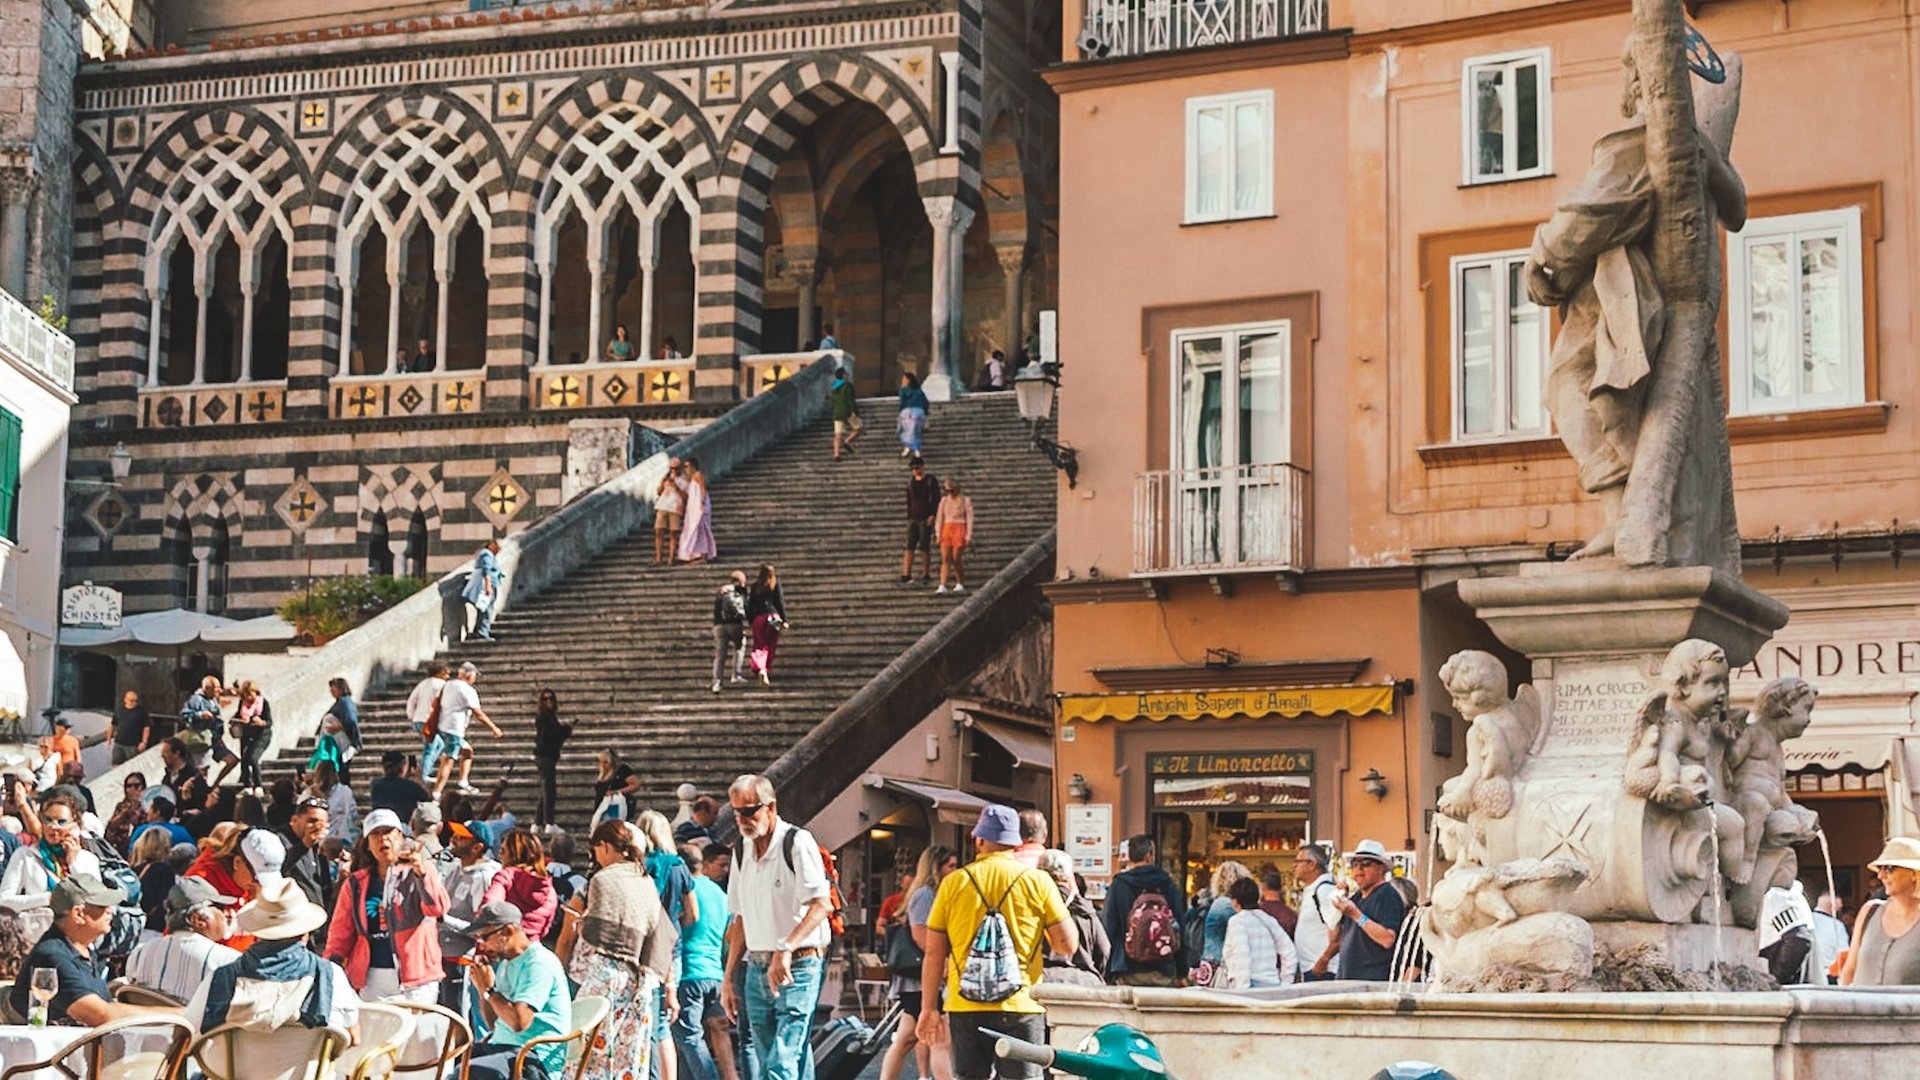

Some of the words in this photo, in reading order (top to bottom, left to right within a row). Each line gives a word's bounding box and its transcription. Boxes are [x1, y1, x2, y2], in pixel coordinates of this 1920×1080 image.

[66, 587, 118, 611] RISTORANTE
[64, 611, 120, 621] CHIOSTRO
[1138, 694, 1188, 713] Antichi
[1195, 691, 1246, 712] Sapori
[1169, 756, 1189, 773] Il
[1198, 754, 1295, 773] Limoncello
